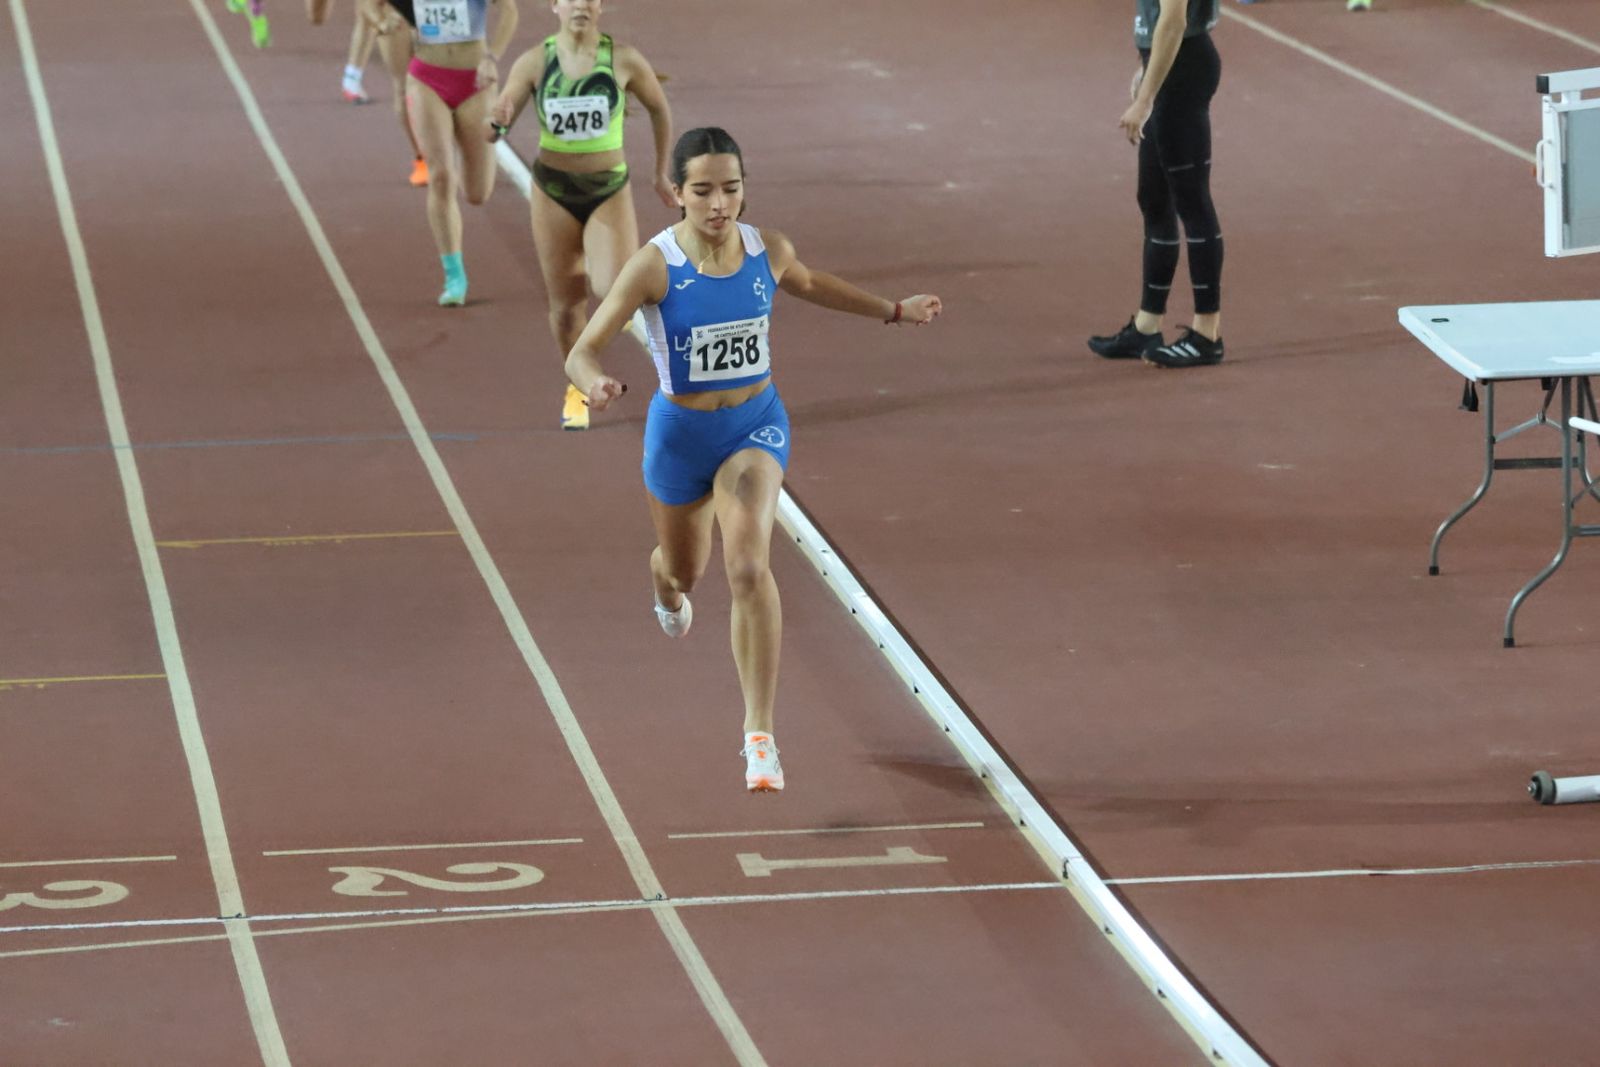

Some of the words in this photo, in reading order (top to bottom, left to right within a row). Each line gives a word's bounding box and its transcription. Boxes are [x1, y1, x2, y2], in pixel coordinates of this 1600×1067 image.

[424, 7, 457, 25] 2154
[551, 110, 604, 135] 2478
[696, 334, 760, 371] 1258
[736, 846, 948, 877] 1
[328, 862, 545, 896] 2
